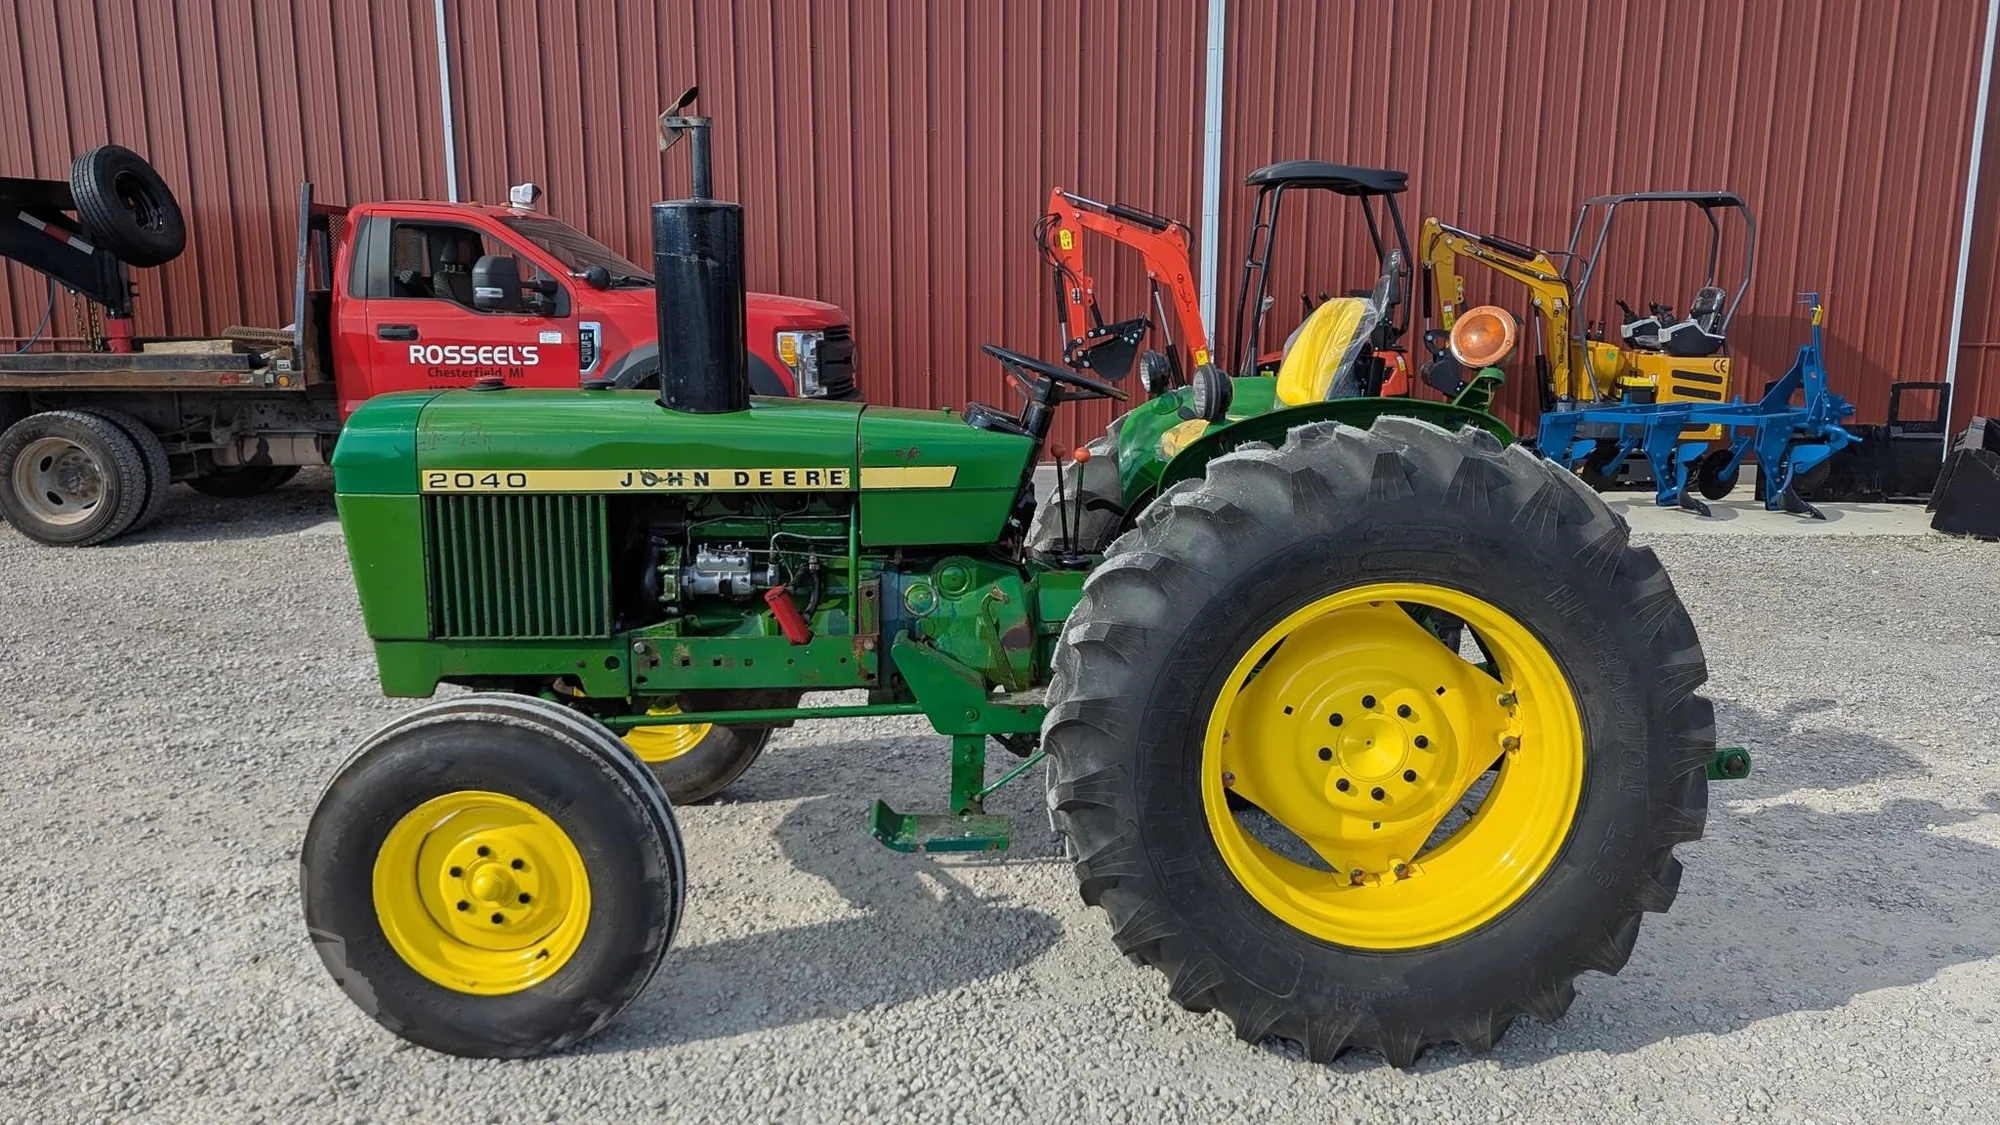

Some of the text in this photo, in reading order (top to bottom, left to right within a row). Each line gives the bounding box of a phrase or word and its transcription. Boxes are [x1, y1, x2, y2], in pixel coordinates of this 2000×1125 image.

[409, 344, 540, 366] ROSSEEL'S
[509, 368, 524, 379] MI
[429, 470, 843, 488] 2040 JOHN DEERE
